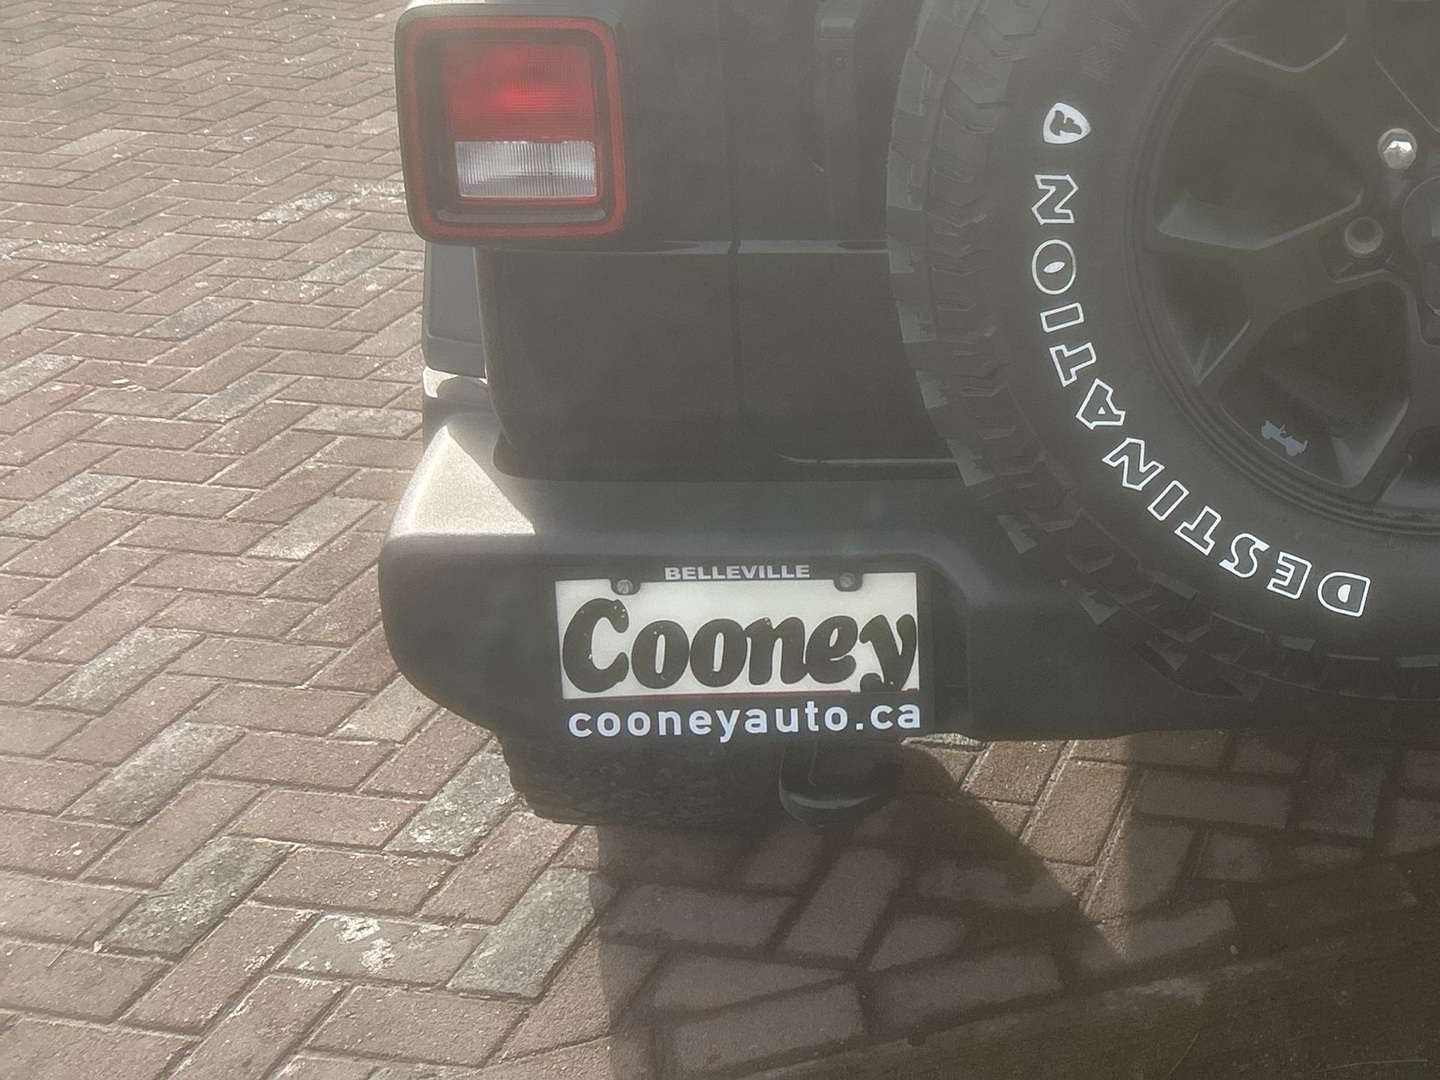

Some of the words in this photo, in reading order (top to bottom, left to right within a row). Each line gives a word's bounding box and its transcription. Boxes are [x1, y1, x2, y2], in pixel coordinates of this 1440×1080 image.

[1031, 174, 1371, 617] DESTINATION
[664, 564, 811, 581] BELLEVILLE
[562, 598, 918, 693] Cooney
[567, 701, 922, 742] cooneyauto.ca
